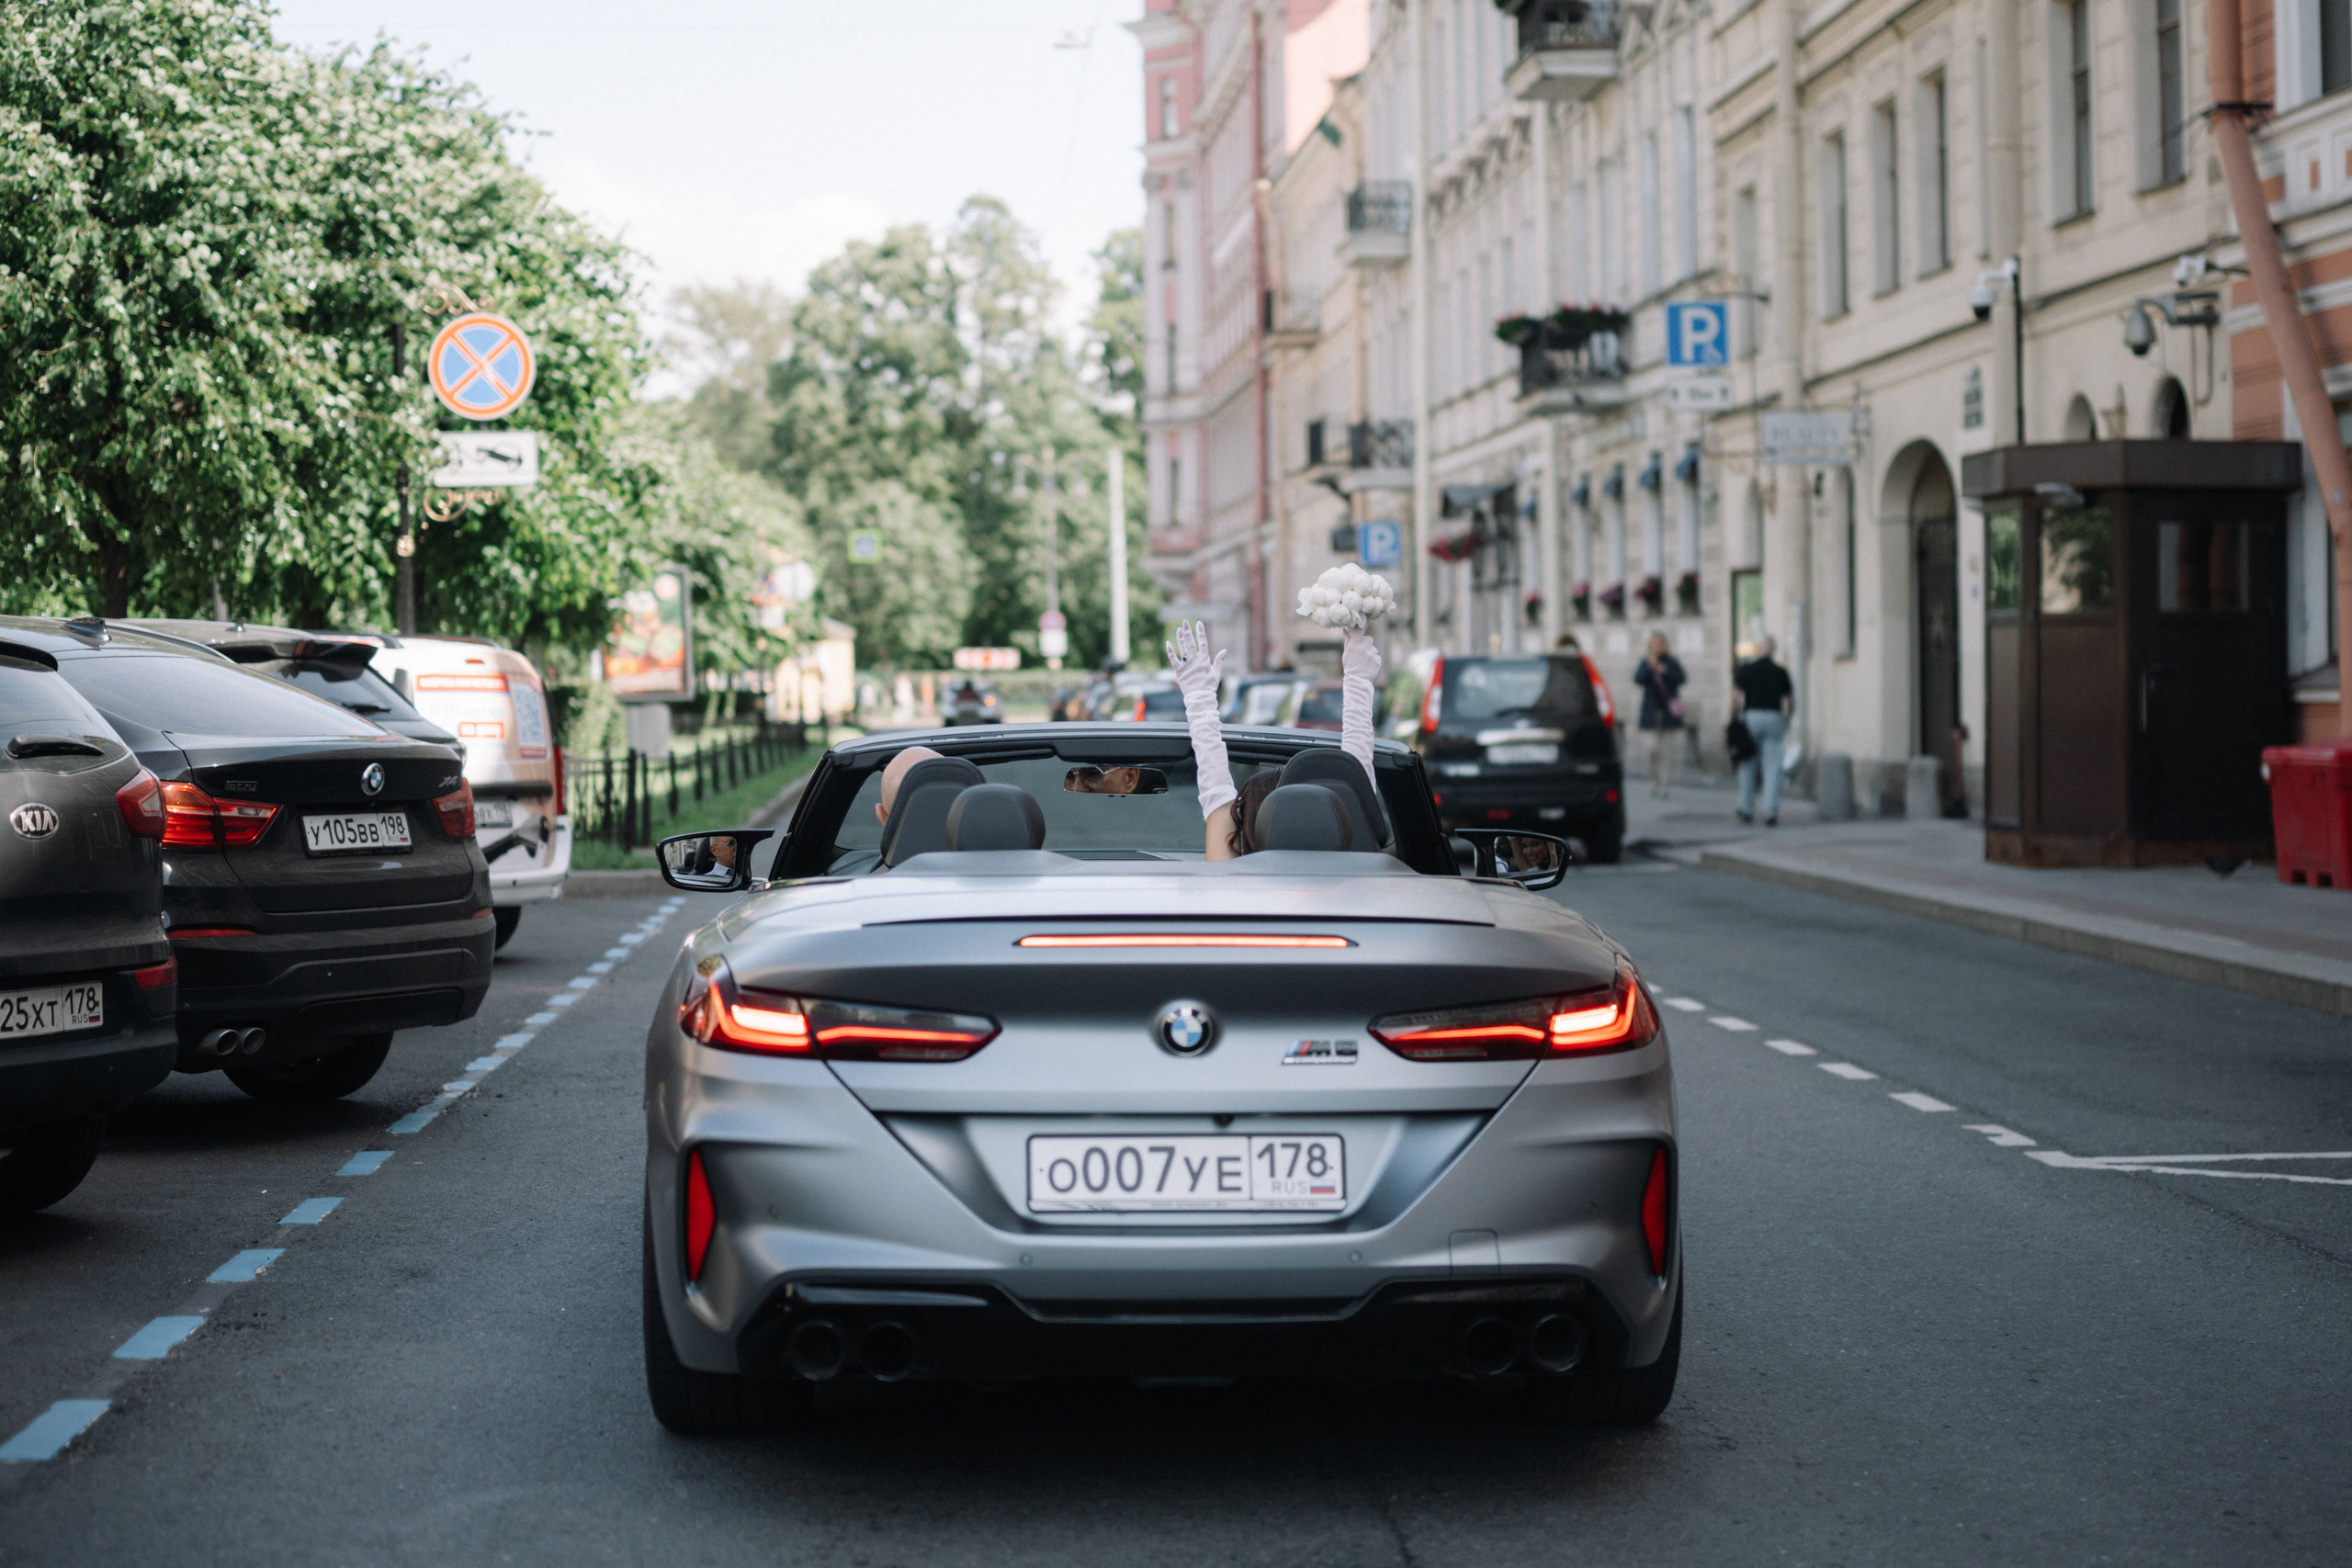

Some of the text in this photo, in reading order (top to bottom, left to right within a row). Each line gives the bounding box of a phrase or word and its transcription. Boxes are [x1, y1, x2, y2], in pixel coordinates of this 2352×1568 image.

[1680, 308, 1720, 362] P
[1369, 526, 1395, 560] P
[20, 809, 53, 831] KIA
[380, 815, 405, 835] 198
[65, 987, 96, 1015] 178
[72, 1013, 89, 1025] RUS
[1257, 1143, 1329, 1179] 178
[1272, 1181, 1310, 1194] RUS
